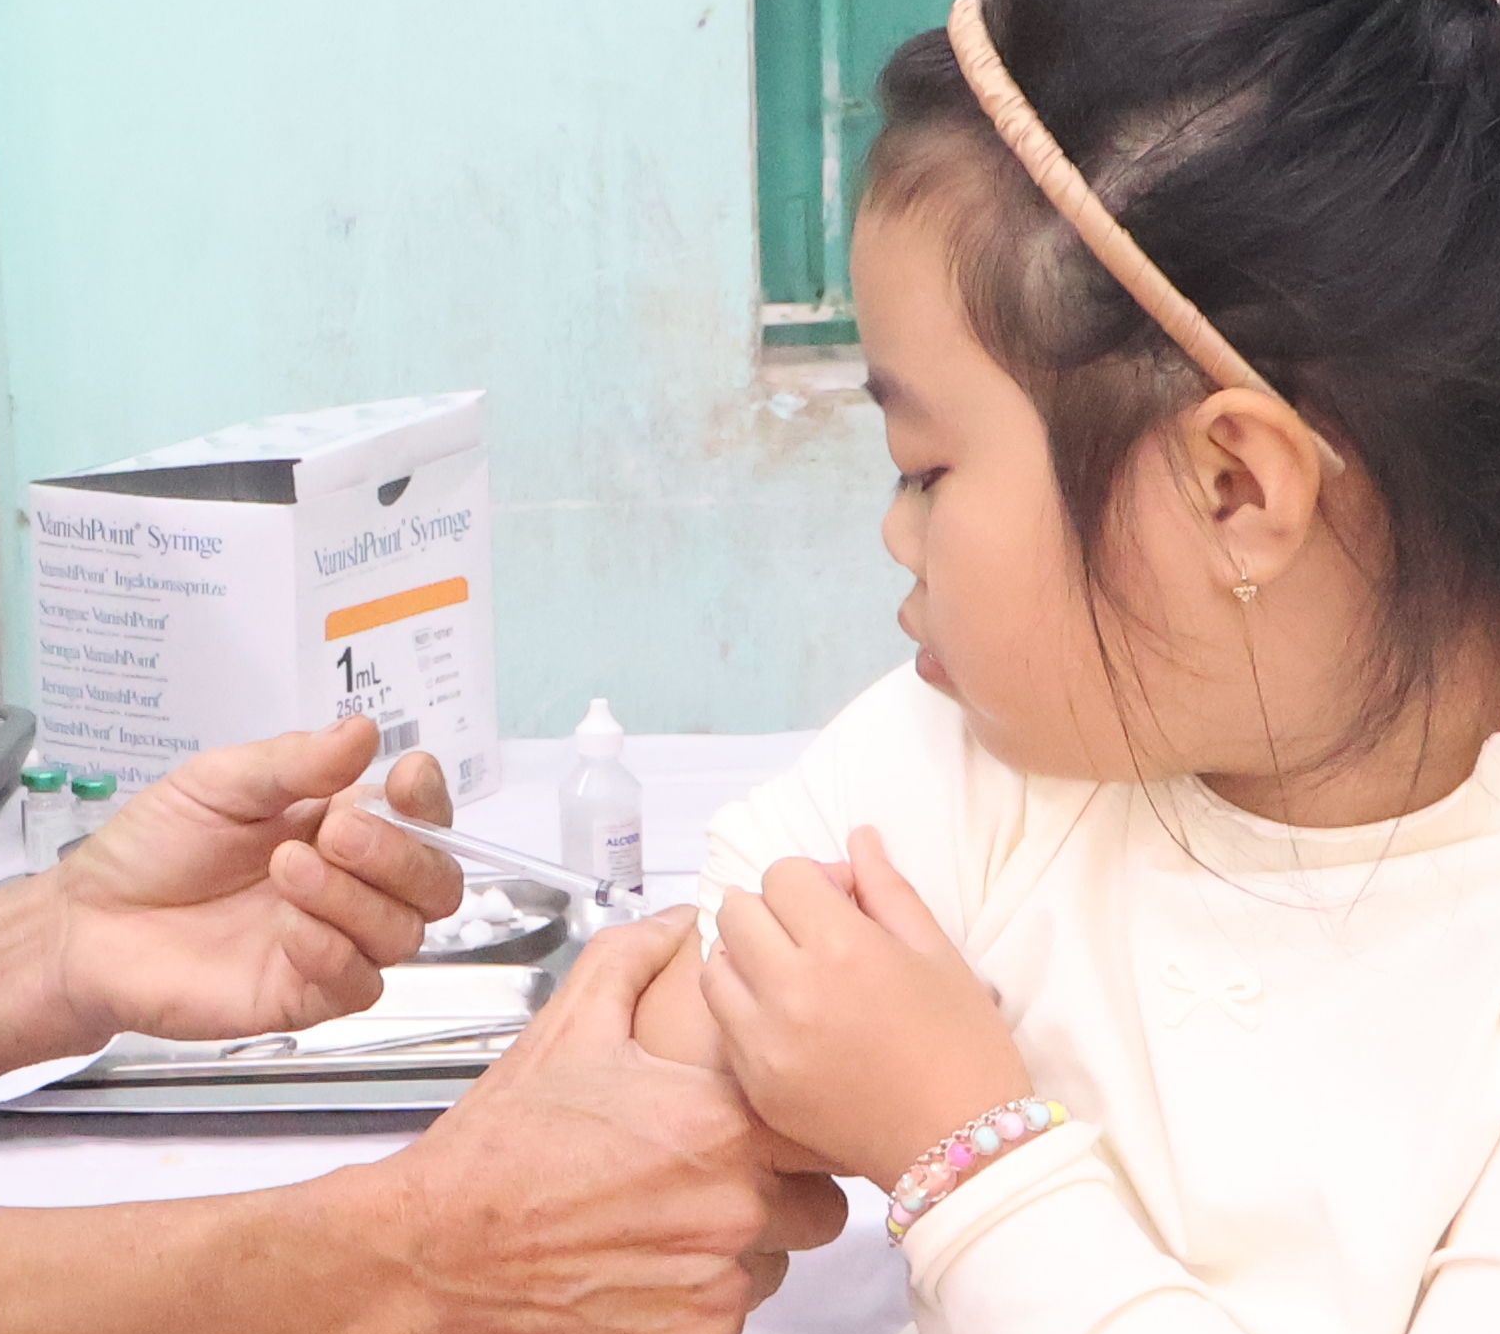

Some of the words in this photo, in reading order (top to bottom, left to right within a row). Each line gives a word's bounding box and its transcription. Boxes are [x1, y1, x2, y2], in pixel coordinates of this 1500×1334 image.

[148, 525, 223, 560] Syringe
[411, 508, 472, 553] Syringe
[336, 695, 363, 719] 25G
